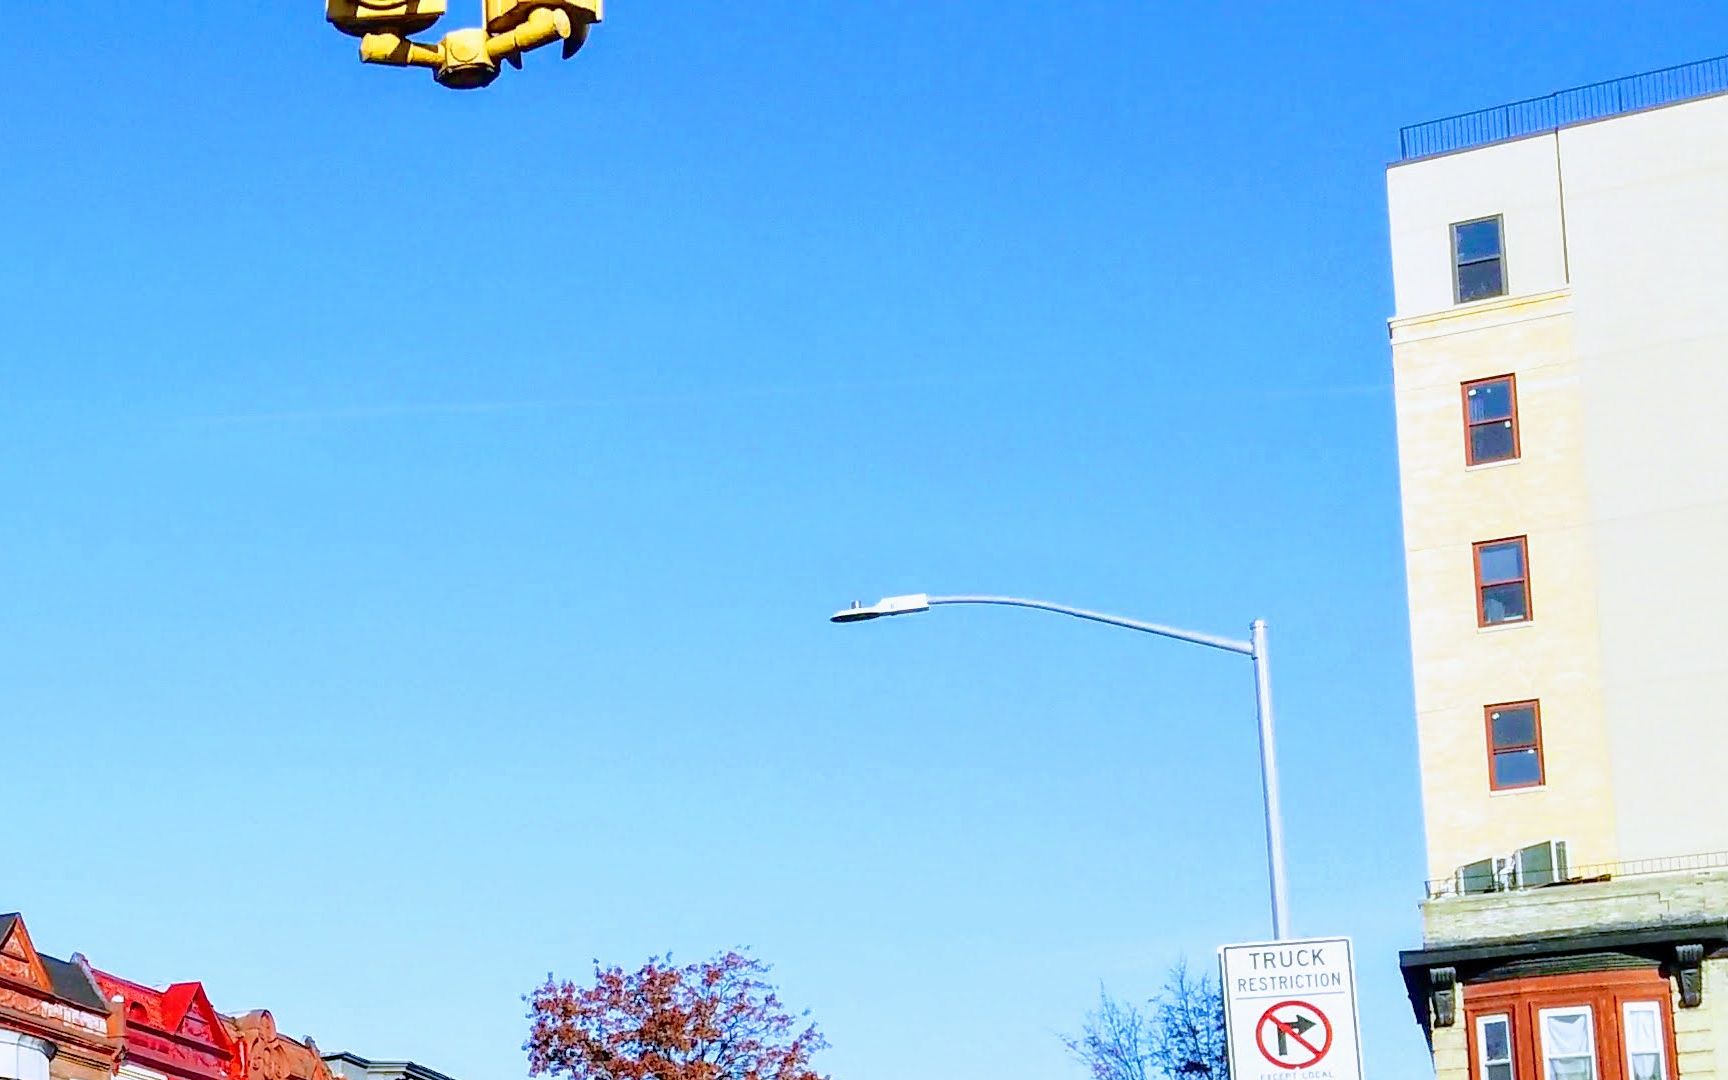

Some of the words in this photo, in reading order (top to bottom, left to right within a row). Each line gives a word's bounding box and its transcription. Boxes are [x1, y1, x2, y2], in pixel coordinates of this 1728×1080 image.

[1249, 948, 1325, 970] TRUCK
[1238, 971, 1341, 993] RESTRICTION
[1302, 1070, 1334, 1080] LOCAL
